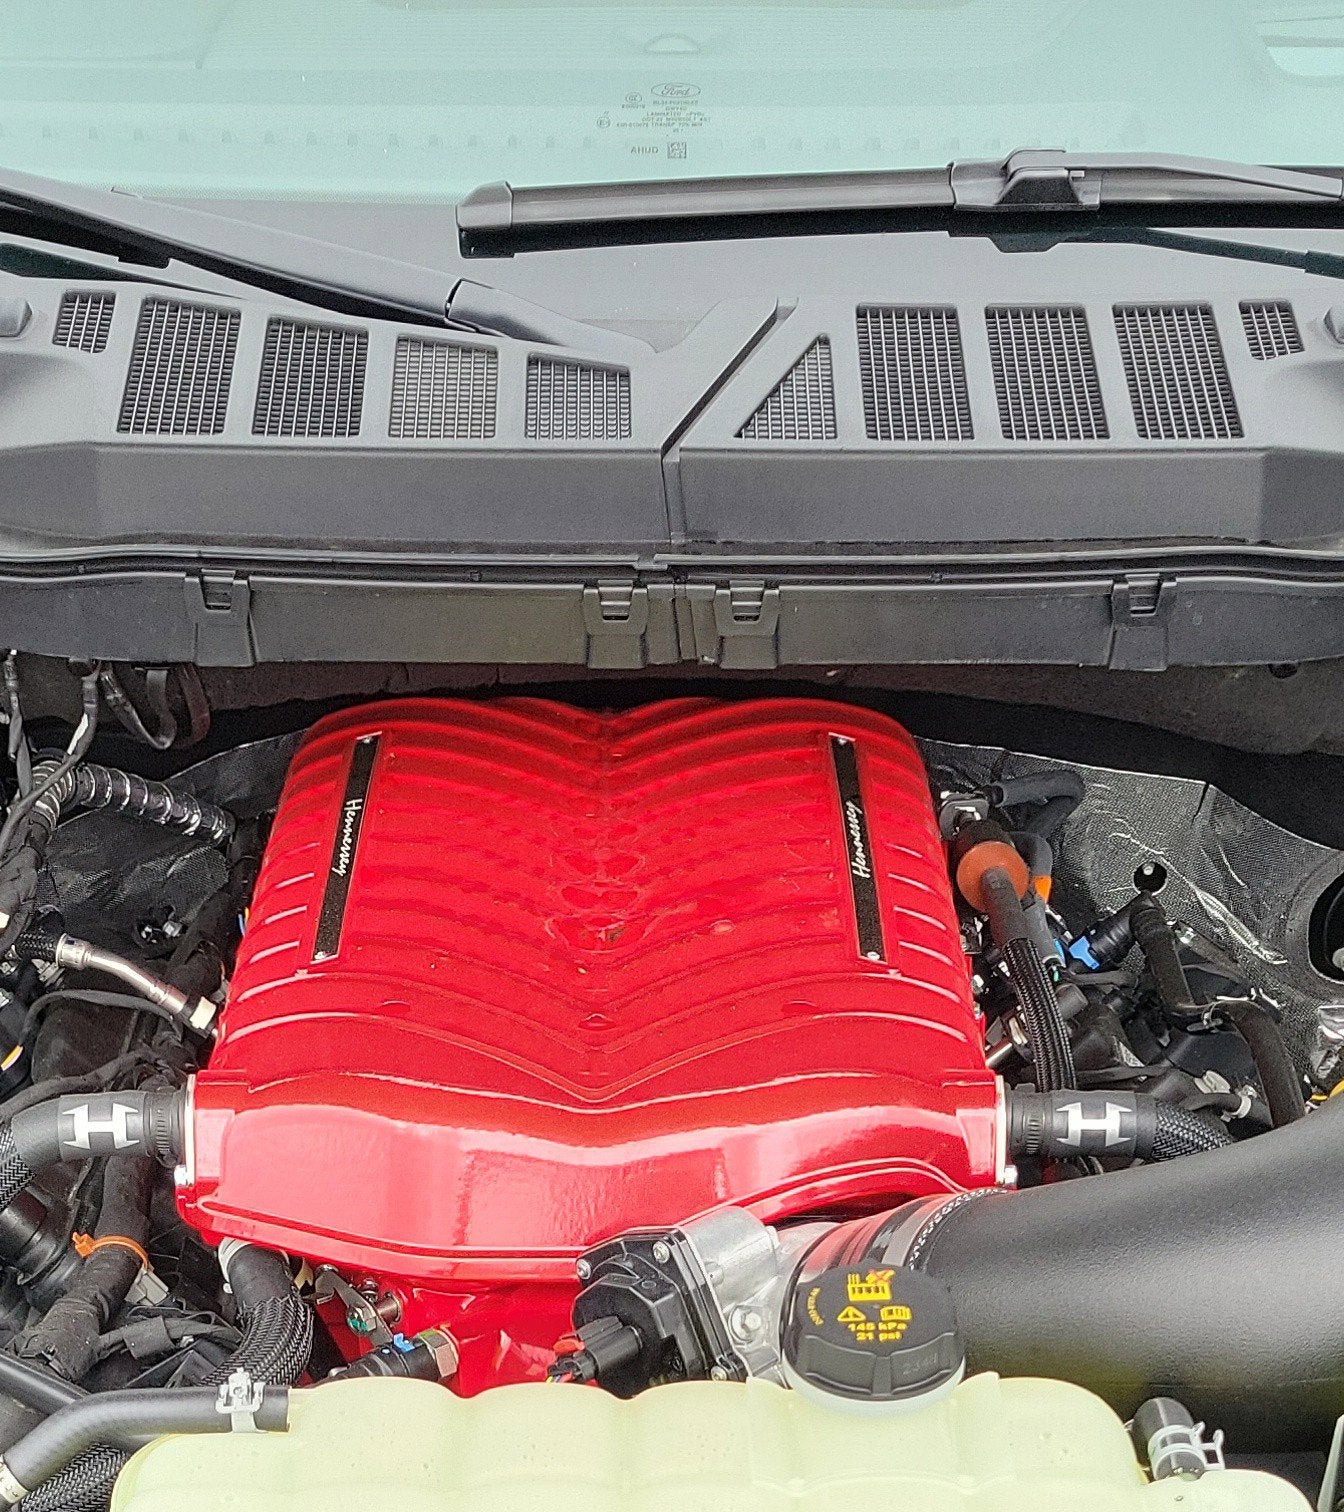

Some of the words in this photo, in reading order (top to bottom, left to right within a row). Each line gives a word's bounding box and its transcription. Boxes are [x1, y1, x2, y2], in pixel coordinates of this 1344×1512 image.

[660, 83, 690, 96] Ford
[630, 145, 659, 154] AHUD
[331, 798, 363, 877] Hennessey
[845, 800, 871, 879] Hennessey
